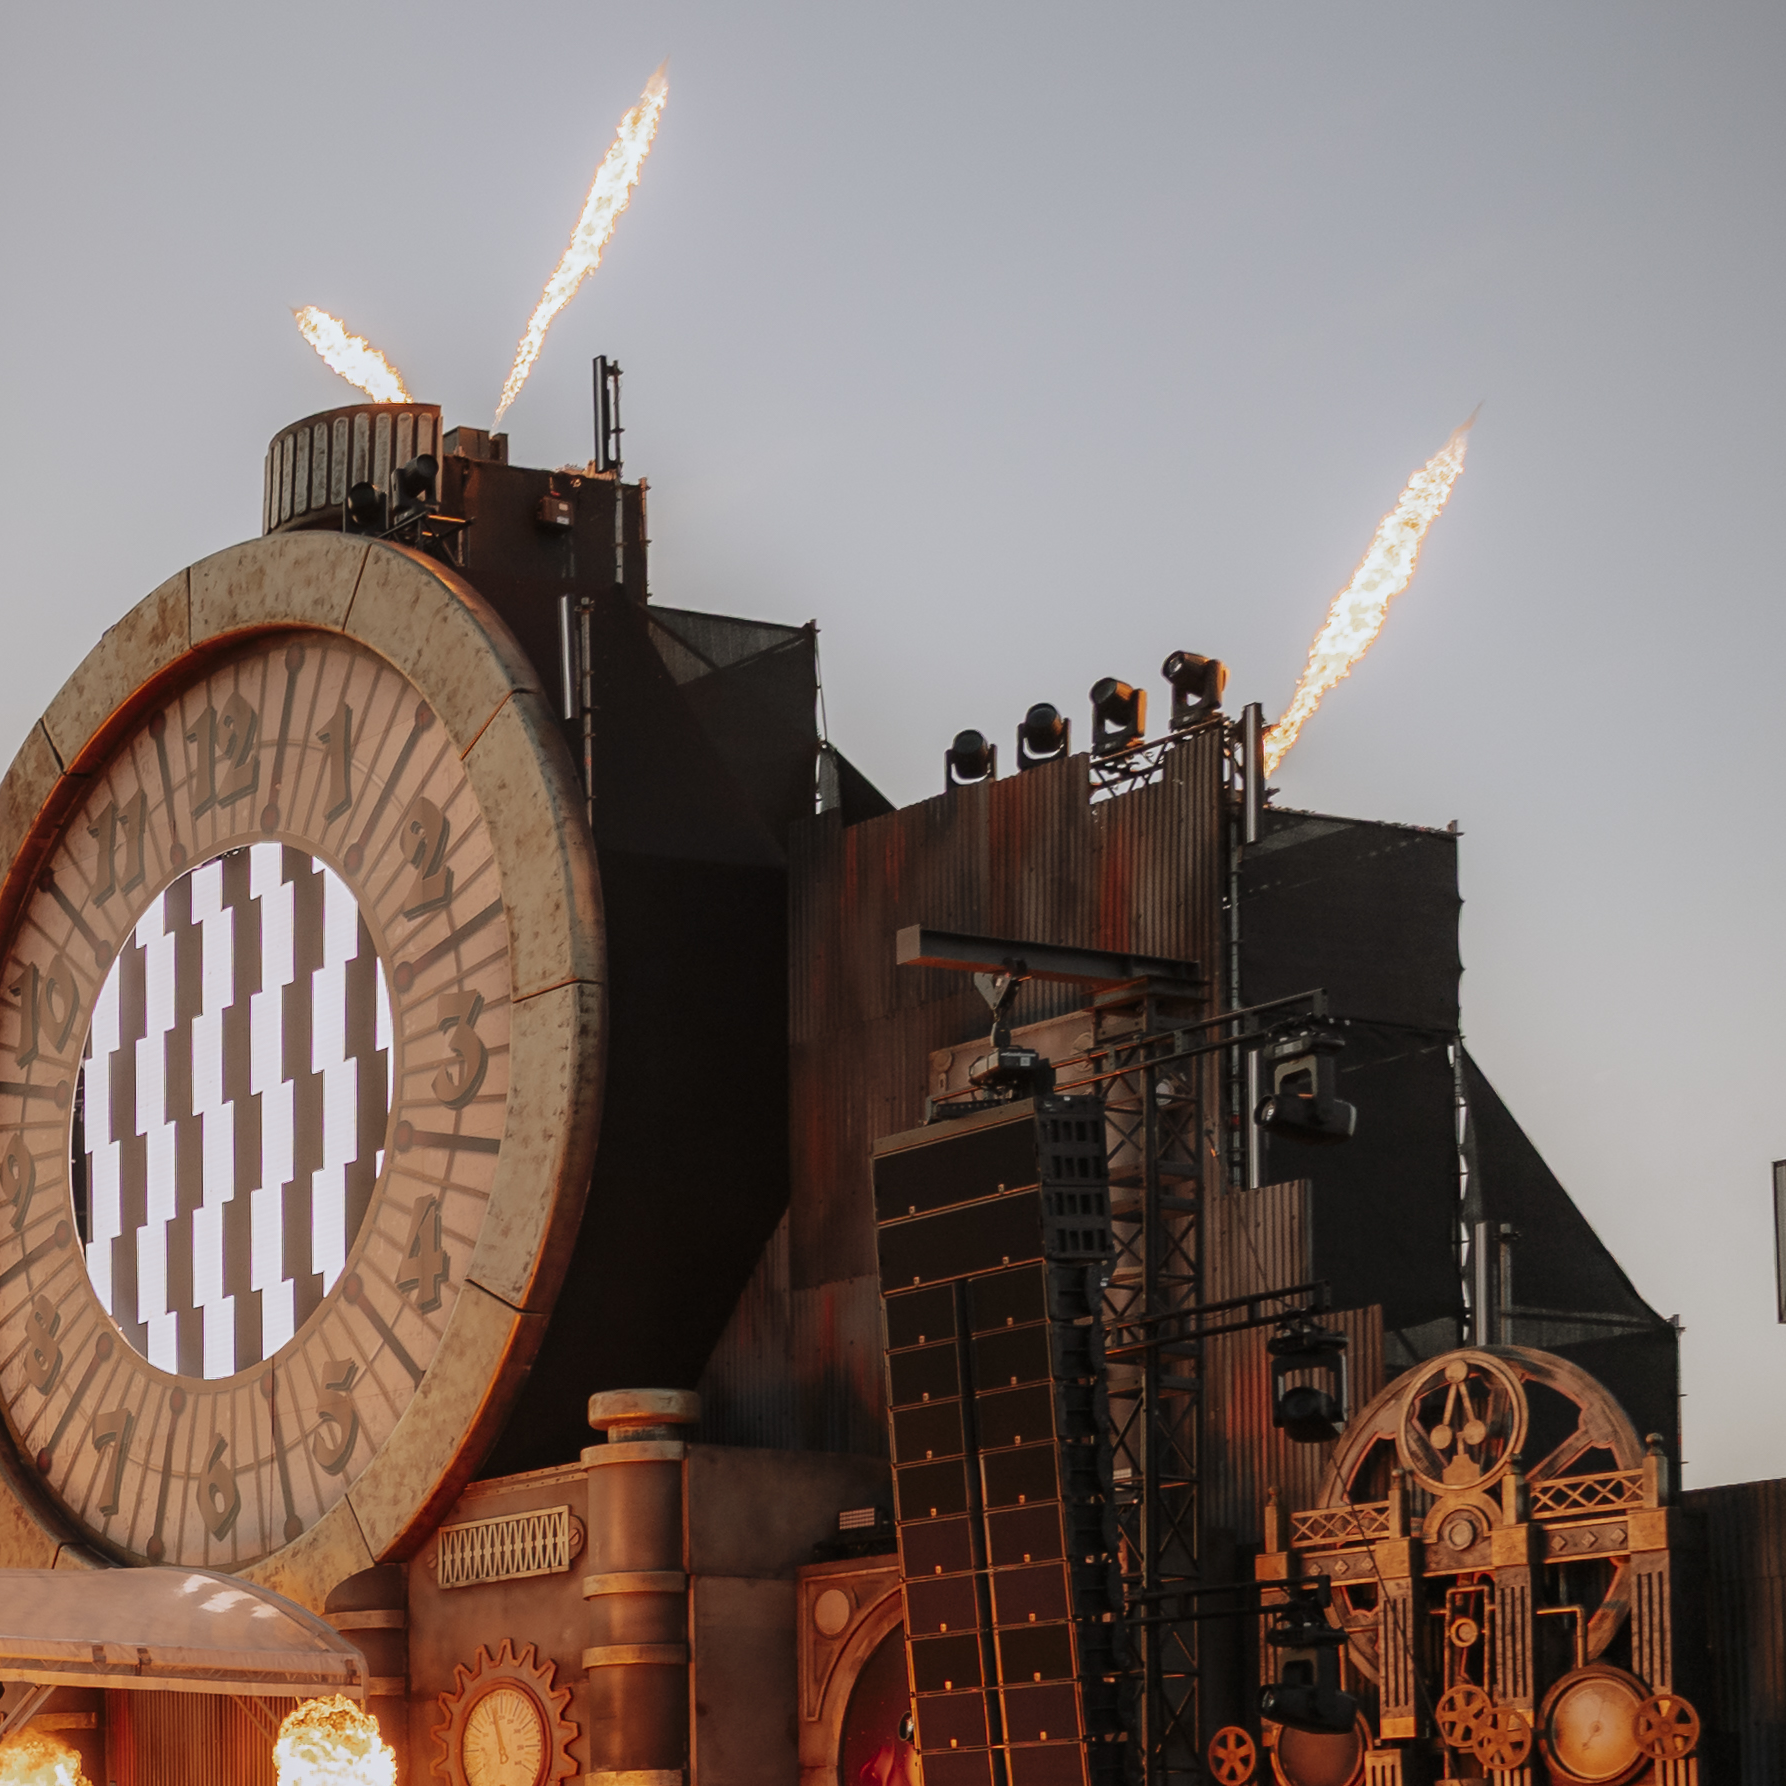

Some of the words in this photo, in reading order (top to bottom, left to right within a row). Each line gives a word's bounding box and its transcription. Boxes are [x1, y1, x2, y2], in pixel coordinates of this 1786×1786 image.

[185, 690, 261, 818] 12
[316, 702, 354, 823] 1
[88, 790, 148, 906] 11
[400, 795, 454, 920] 2
[8, 951, 80, 1068] 10
[432, 988, 488, 1110] 3
[0, 1133, 37, 1230] 9
[397, 1193, 449, 1312] 4
[25, 1295, 62, 1394] 8
[92, 1405, 135, 1514] 7
[314, 1358, 359, 1475] 5
[197, 1432, 242, 1541] 6
